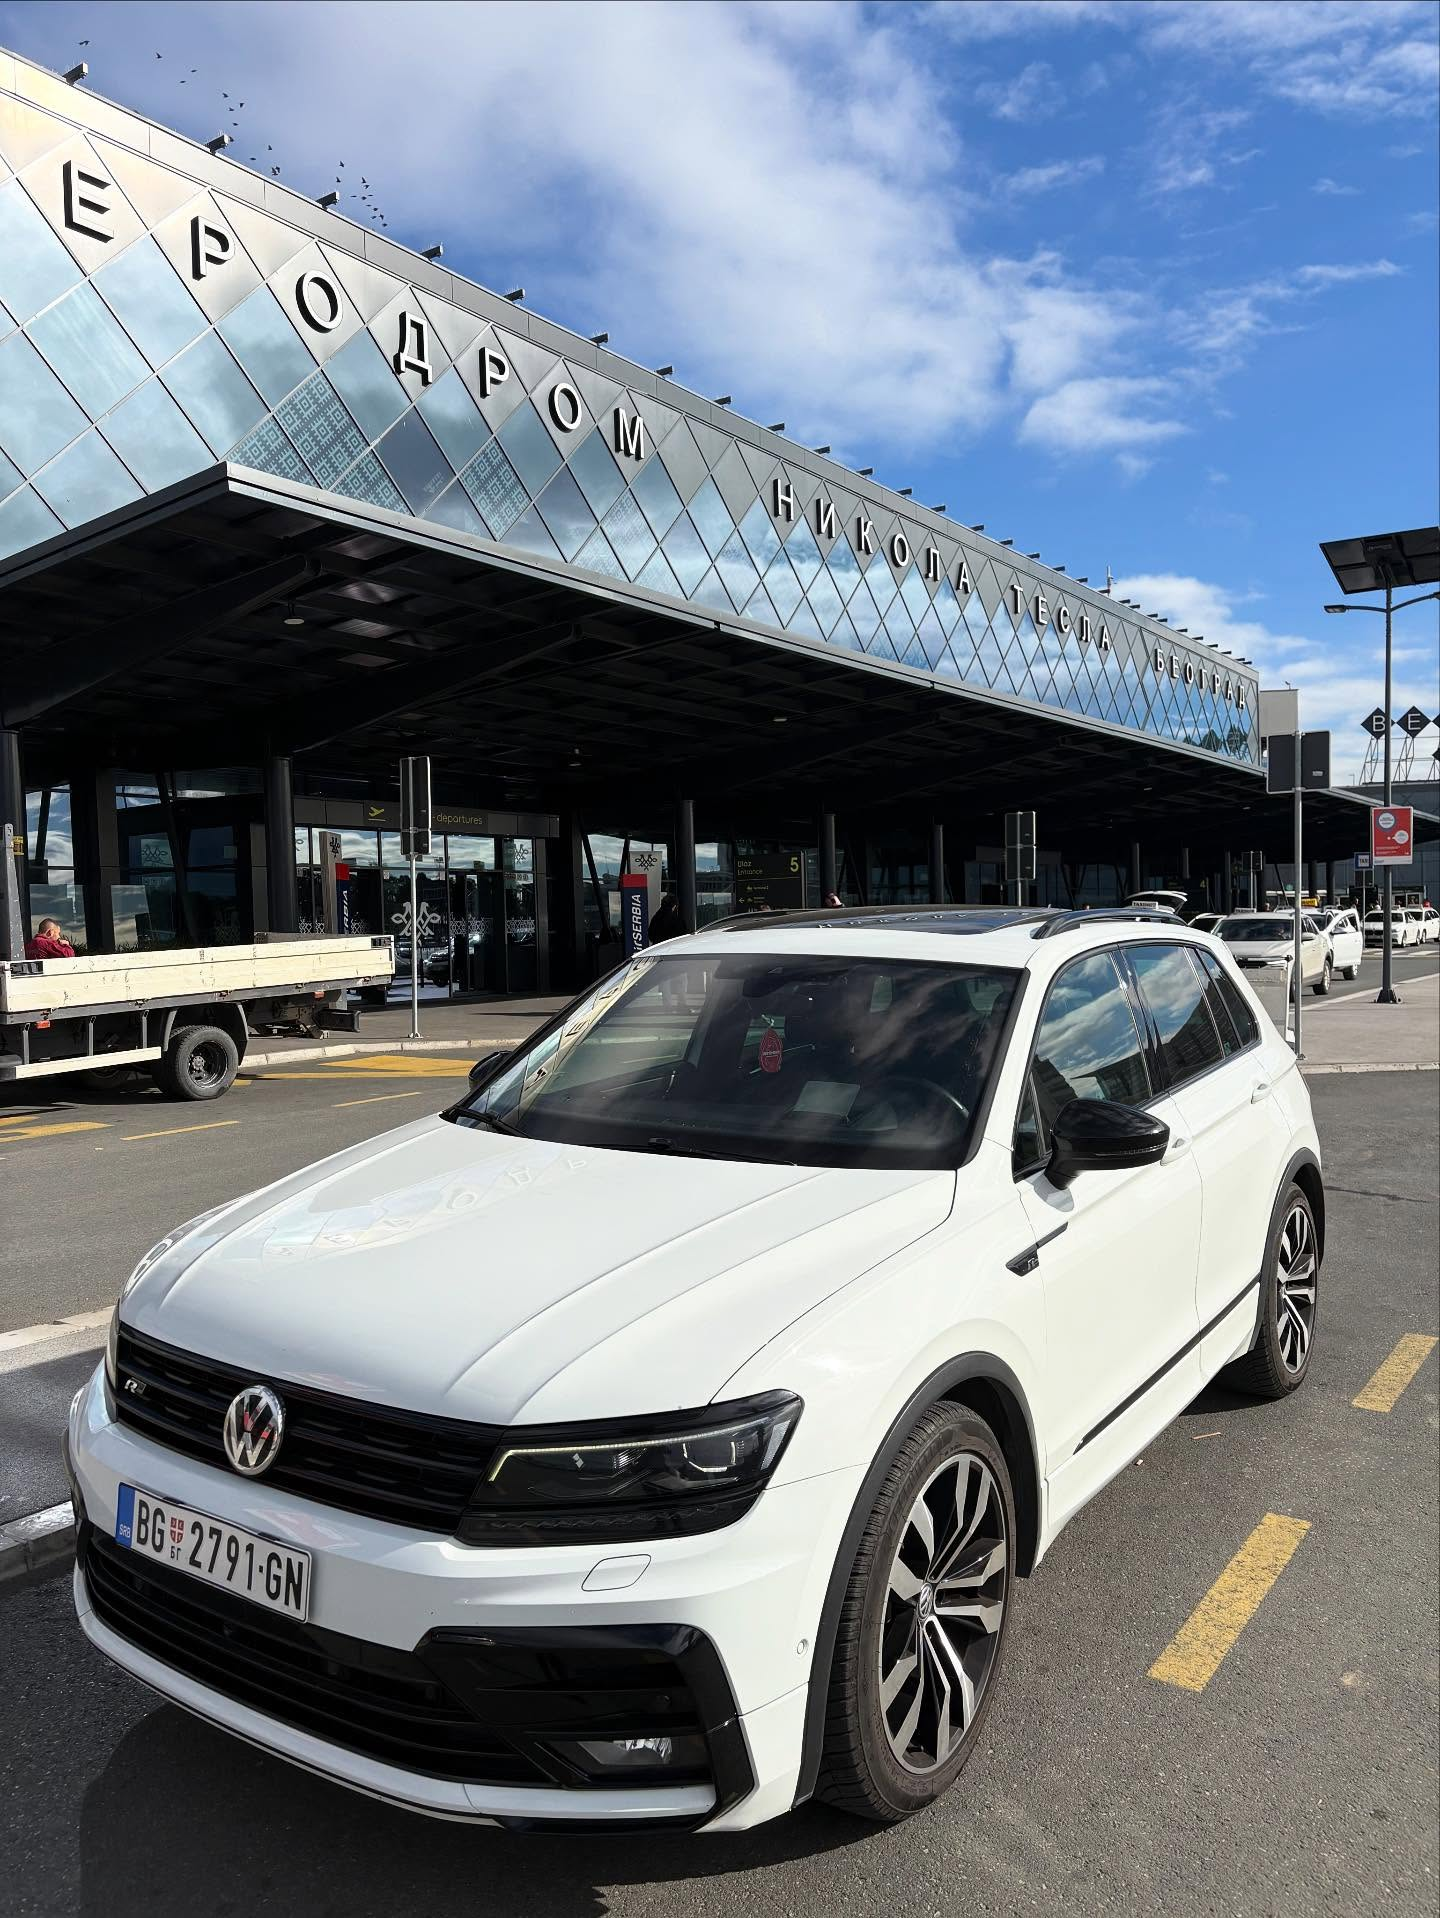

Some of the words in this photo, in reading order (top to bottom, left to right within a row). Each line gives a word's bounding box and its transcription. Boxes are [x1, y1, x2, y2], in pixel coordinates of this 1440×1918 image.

[773, 478, 971, 594] НИКОЛА
[1010, 584, 1111, 651] ТЕСЛА
[1154, 648, 1246, 708] БЕОГРАД
[790, 857, 799, 872] 5
[631, 894, 643, 954] irSERBIA
[118, 1523, 131, 1538] SRB
[136, 1499, 166, 1552] BG
